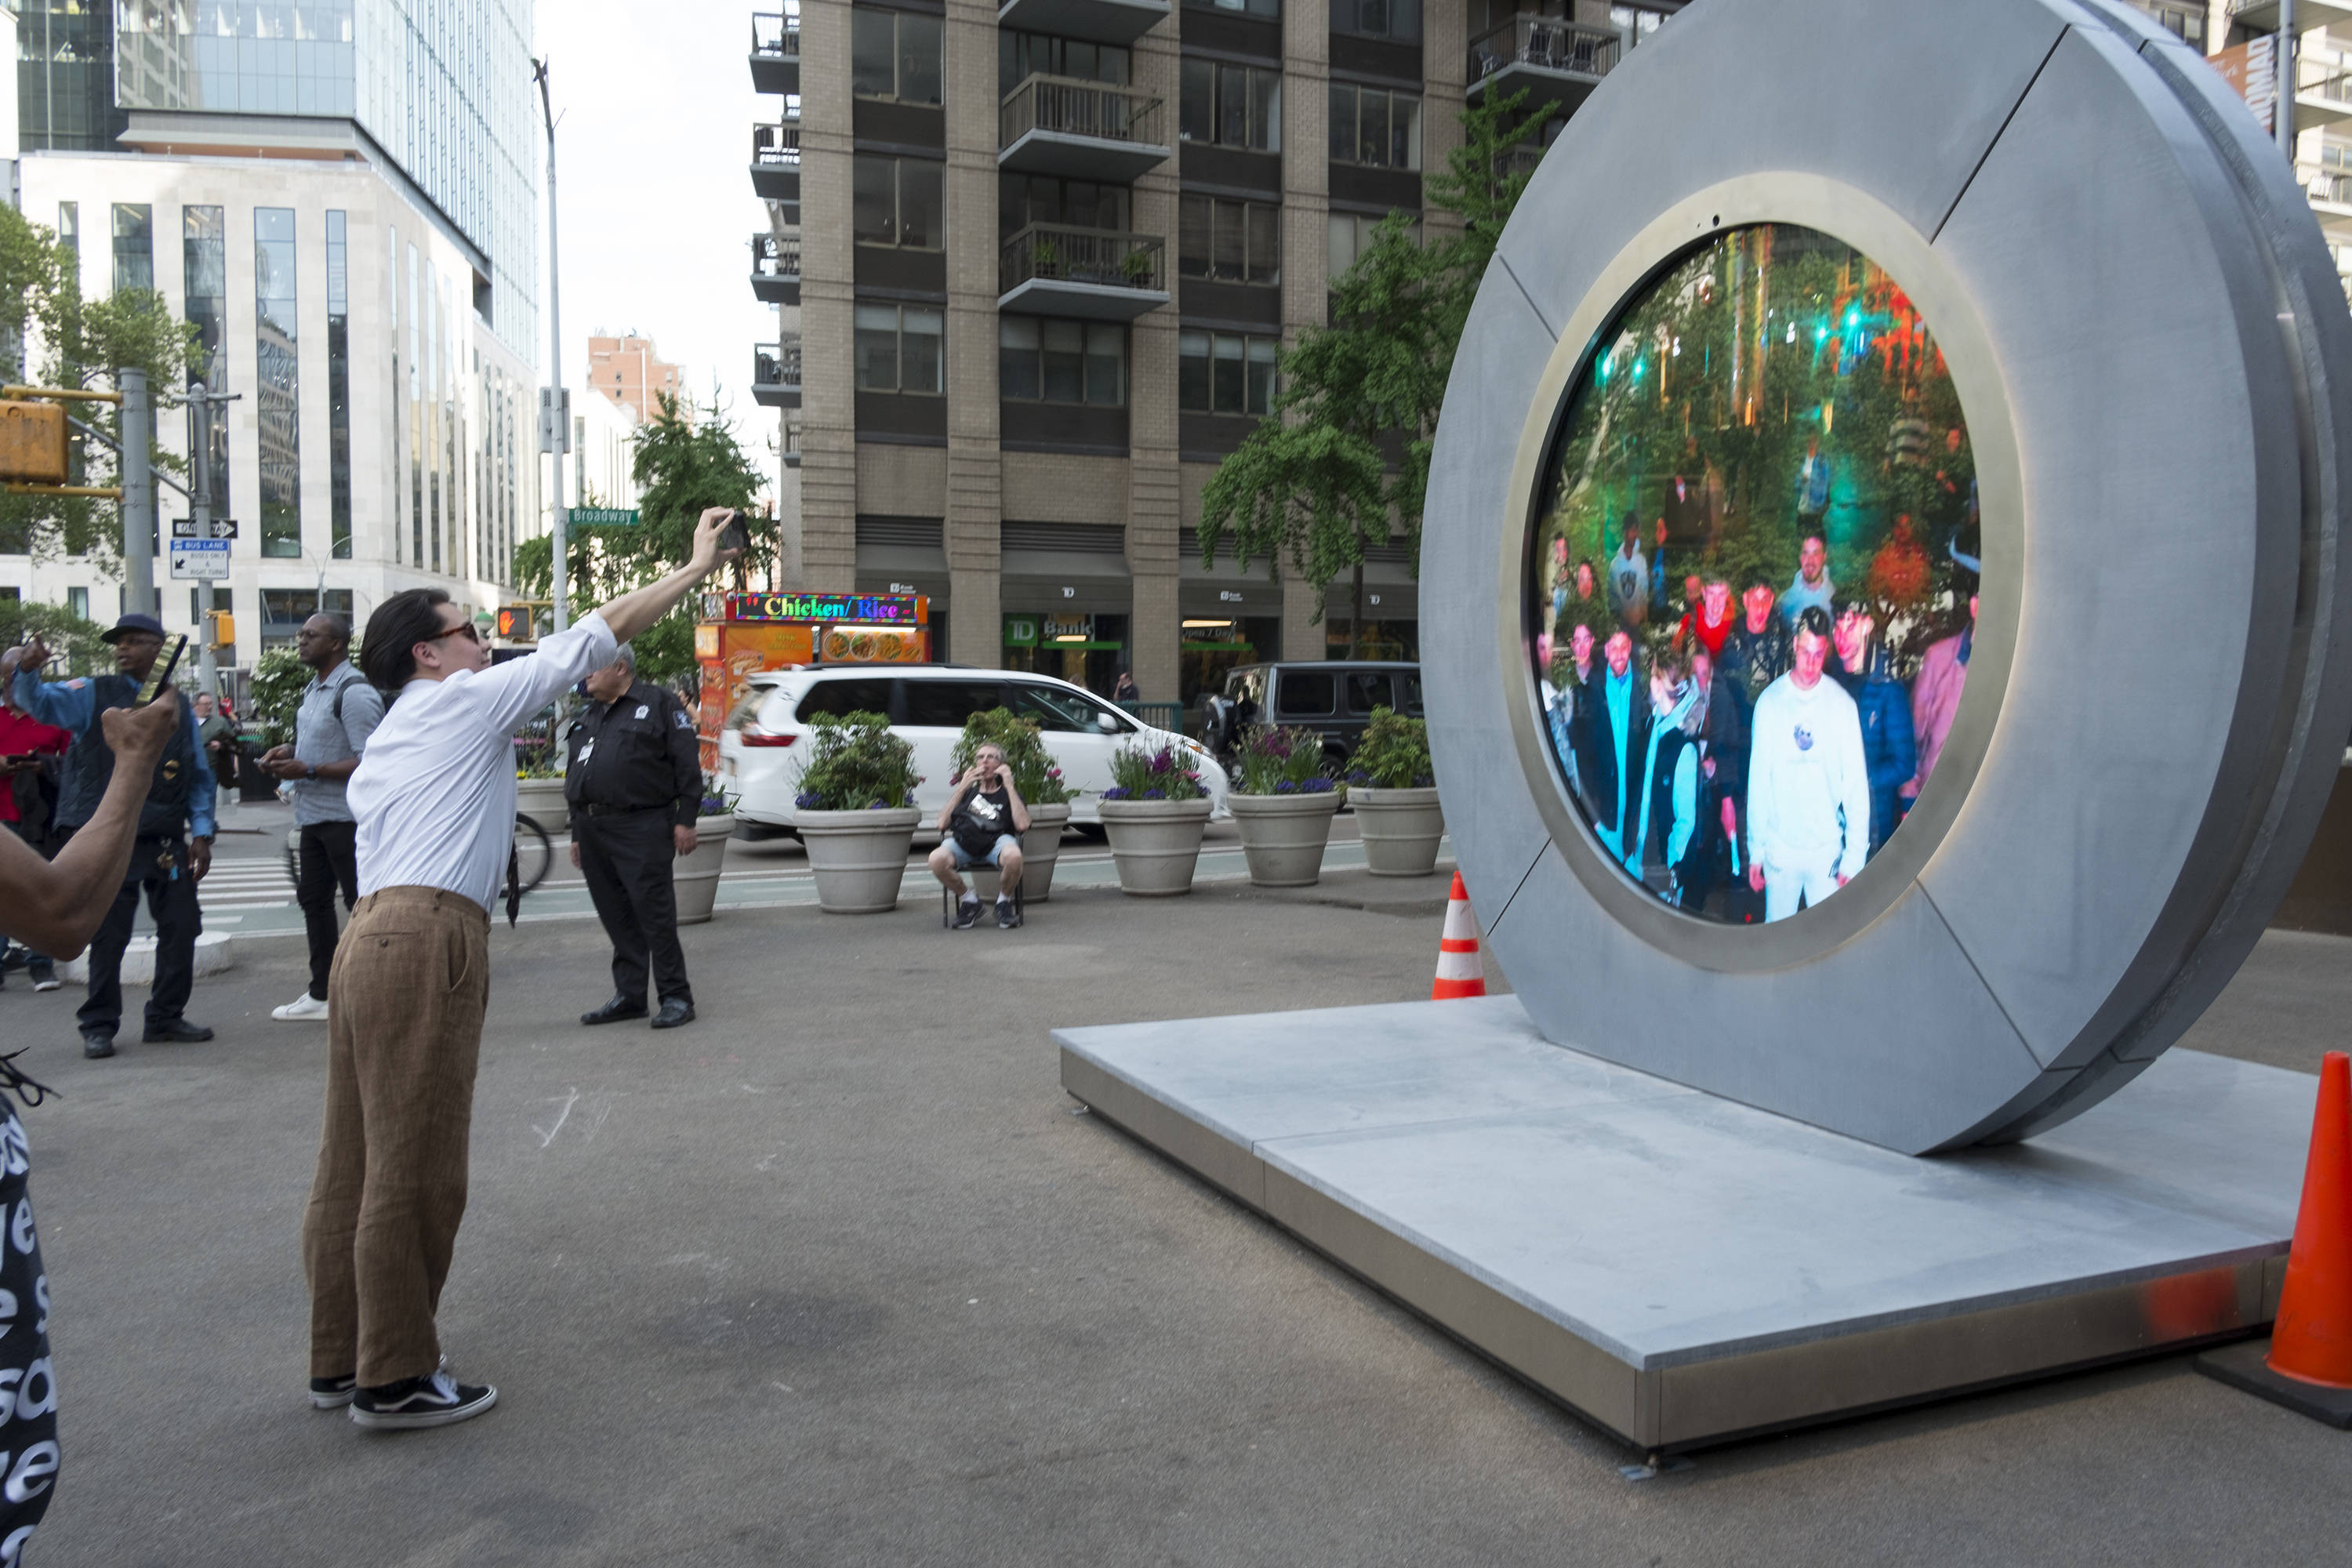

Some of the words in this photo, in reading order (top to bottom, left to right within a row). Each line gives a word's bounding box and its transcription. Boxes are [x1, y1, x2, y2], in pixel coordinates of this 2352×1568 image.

[574, 510, 632, 525] Broadway
[185, 540, 201, 549] BUS
[203, 540, 225, 550] LANE
[1062, 586, 1074, 597] TD
[856, 600, 898, 618] Rice
[1008, 620, 1035, 641] TD
[1044, 620, 1092, 635] Bank
